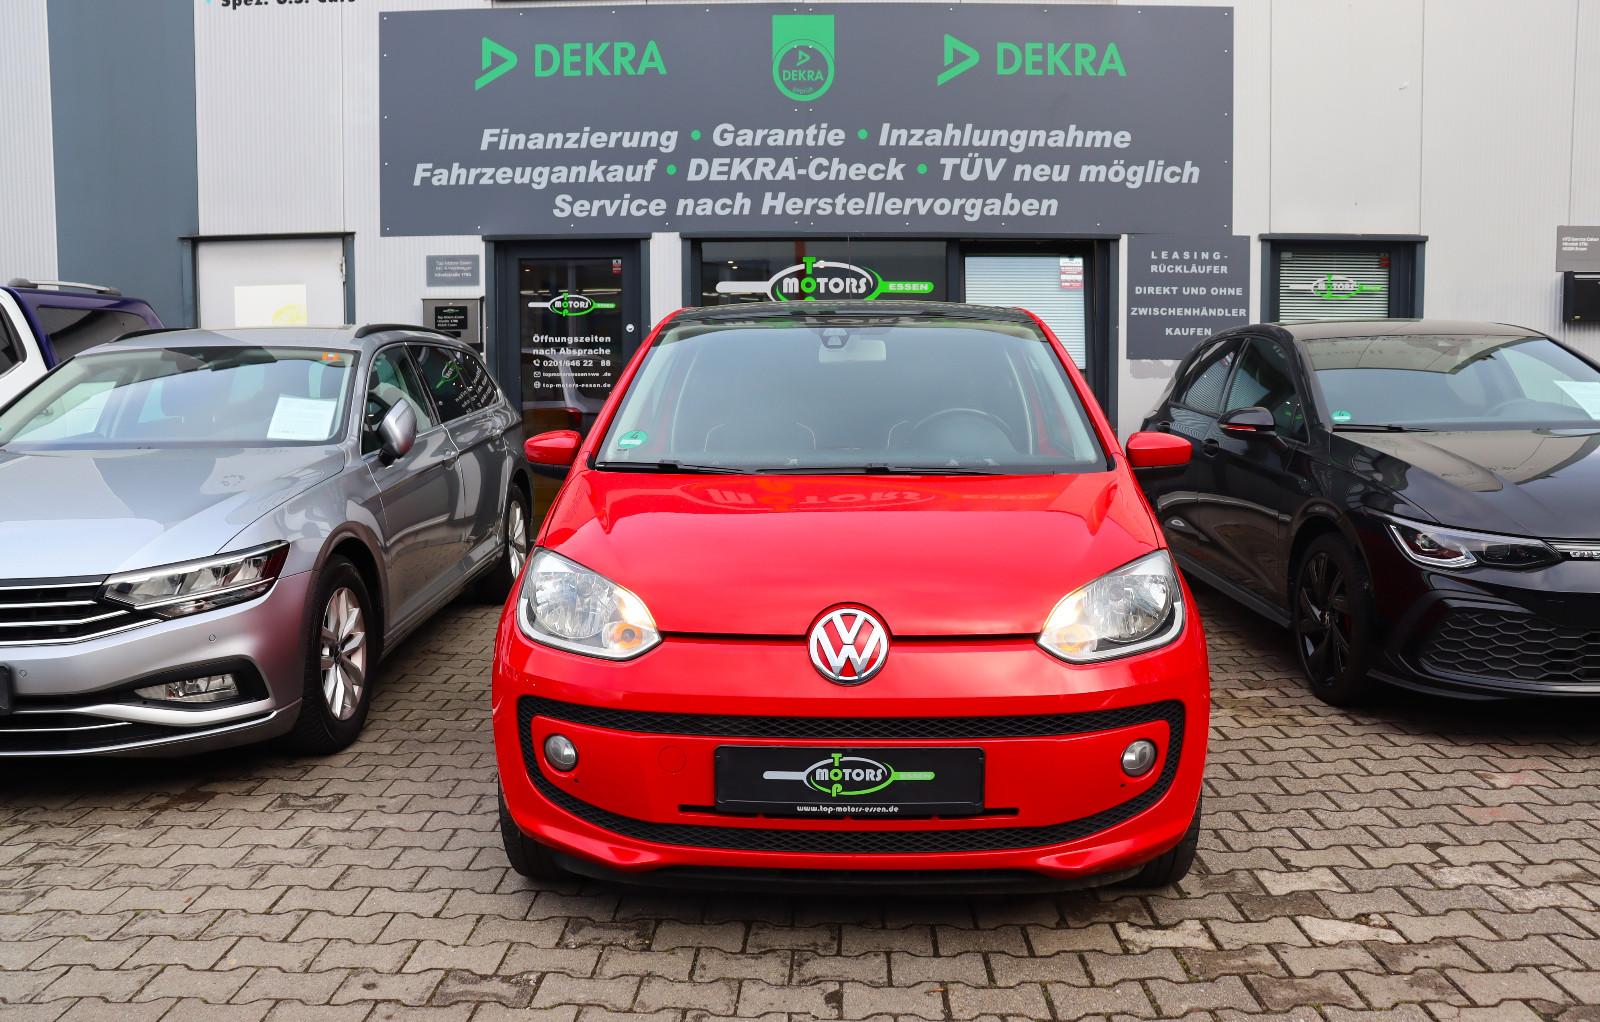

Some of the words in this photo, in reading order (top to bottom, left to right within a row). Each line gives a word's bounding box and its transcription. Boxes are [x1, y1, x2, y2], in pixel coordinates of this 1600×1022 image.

[534, 40, 667, 77] DEKRA
[997, 41, 1127, 76] DEKRA
[782, 69, 825, 81] DEKRA
[480, 126, 678, 153] Finanzierung
[712, 122, 846, 147] Garantie
[878, 122, 1132, 153] Inzahlungnahme
[413, 158, 658, 189] Fahrzeugankauf
[686, 156, 907, 182] DEKRA-Check
[939, 153, 1007, 183] TÜV
[1013, 163, 1071, 183] neu
[1078, 159, 1200, 189] möglich
[552, 193, 667, 218] Service
[675, 192, 752, 216] nach
[760, 192, 1059, 222] Herstellervorgaben
[1150, 263, 1228, 274] RÜCKLÄUFER
[783, 277, 867, 294] MOTORS
[889, 283, 929, 291] ESSEN
[1135, 286, 1178, 295] DIREKT
[1182, 286, 1207, 296] UND
[1210, 287, 1243, 296] OHNE
[1130, 306, 1247, 317] ZWISCHENHÄNDLER
[1165, 327, 1212, 336] KAUFEN
[532, 334, 612, 344] Öffnungszeiten
[532, 347, 557, 355] nach
[559, 347, 611, 357] Absprache
[815, 768, 884, 782] MOTORS
[796, 805, 899, 814] www.top-motors-essen.de
